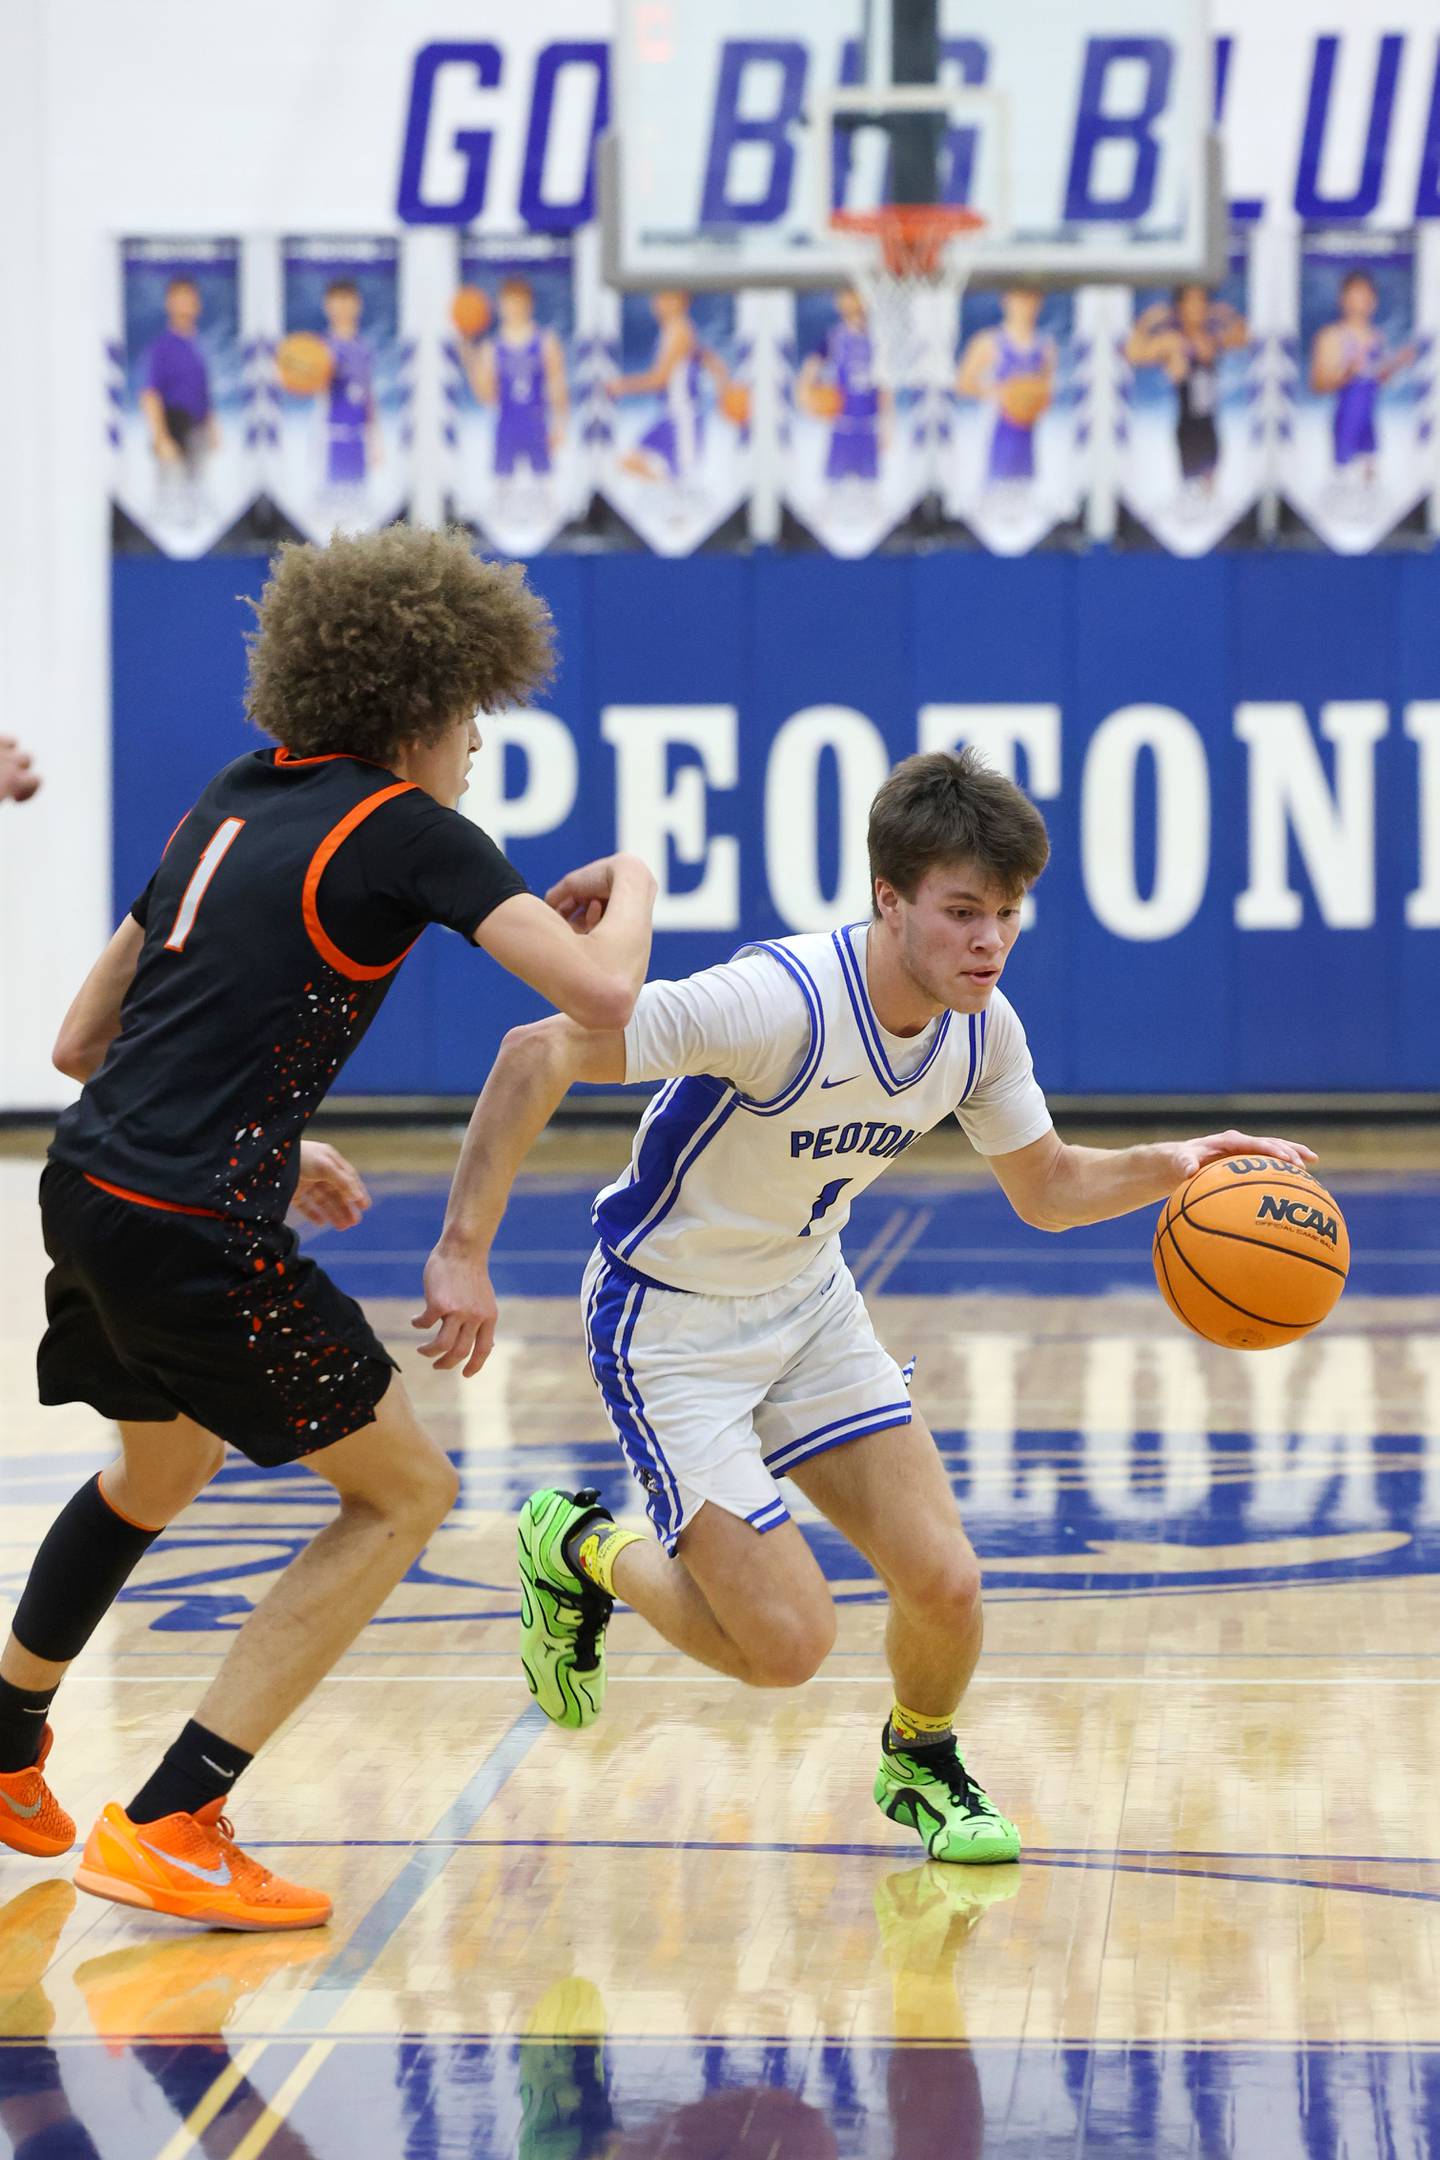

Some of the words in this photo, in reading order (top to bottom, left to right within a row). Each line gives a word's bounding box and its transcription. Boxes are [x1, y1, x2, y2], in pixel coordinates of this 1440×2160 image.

[397, 42, 610, 225] GO
[1062, 36, 1440, 222] BU
[164, 816, 247, 952] 1
[457, 700, 1440, 941] PEOTON
[797, 1177, 854, 1237] 1
[1257, 1194, 1338, 1246] NCAA
